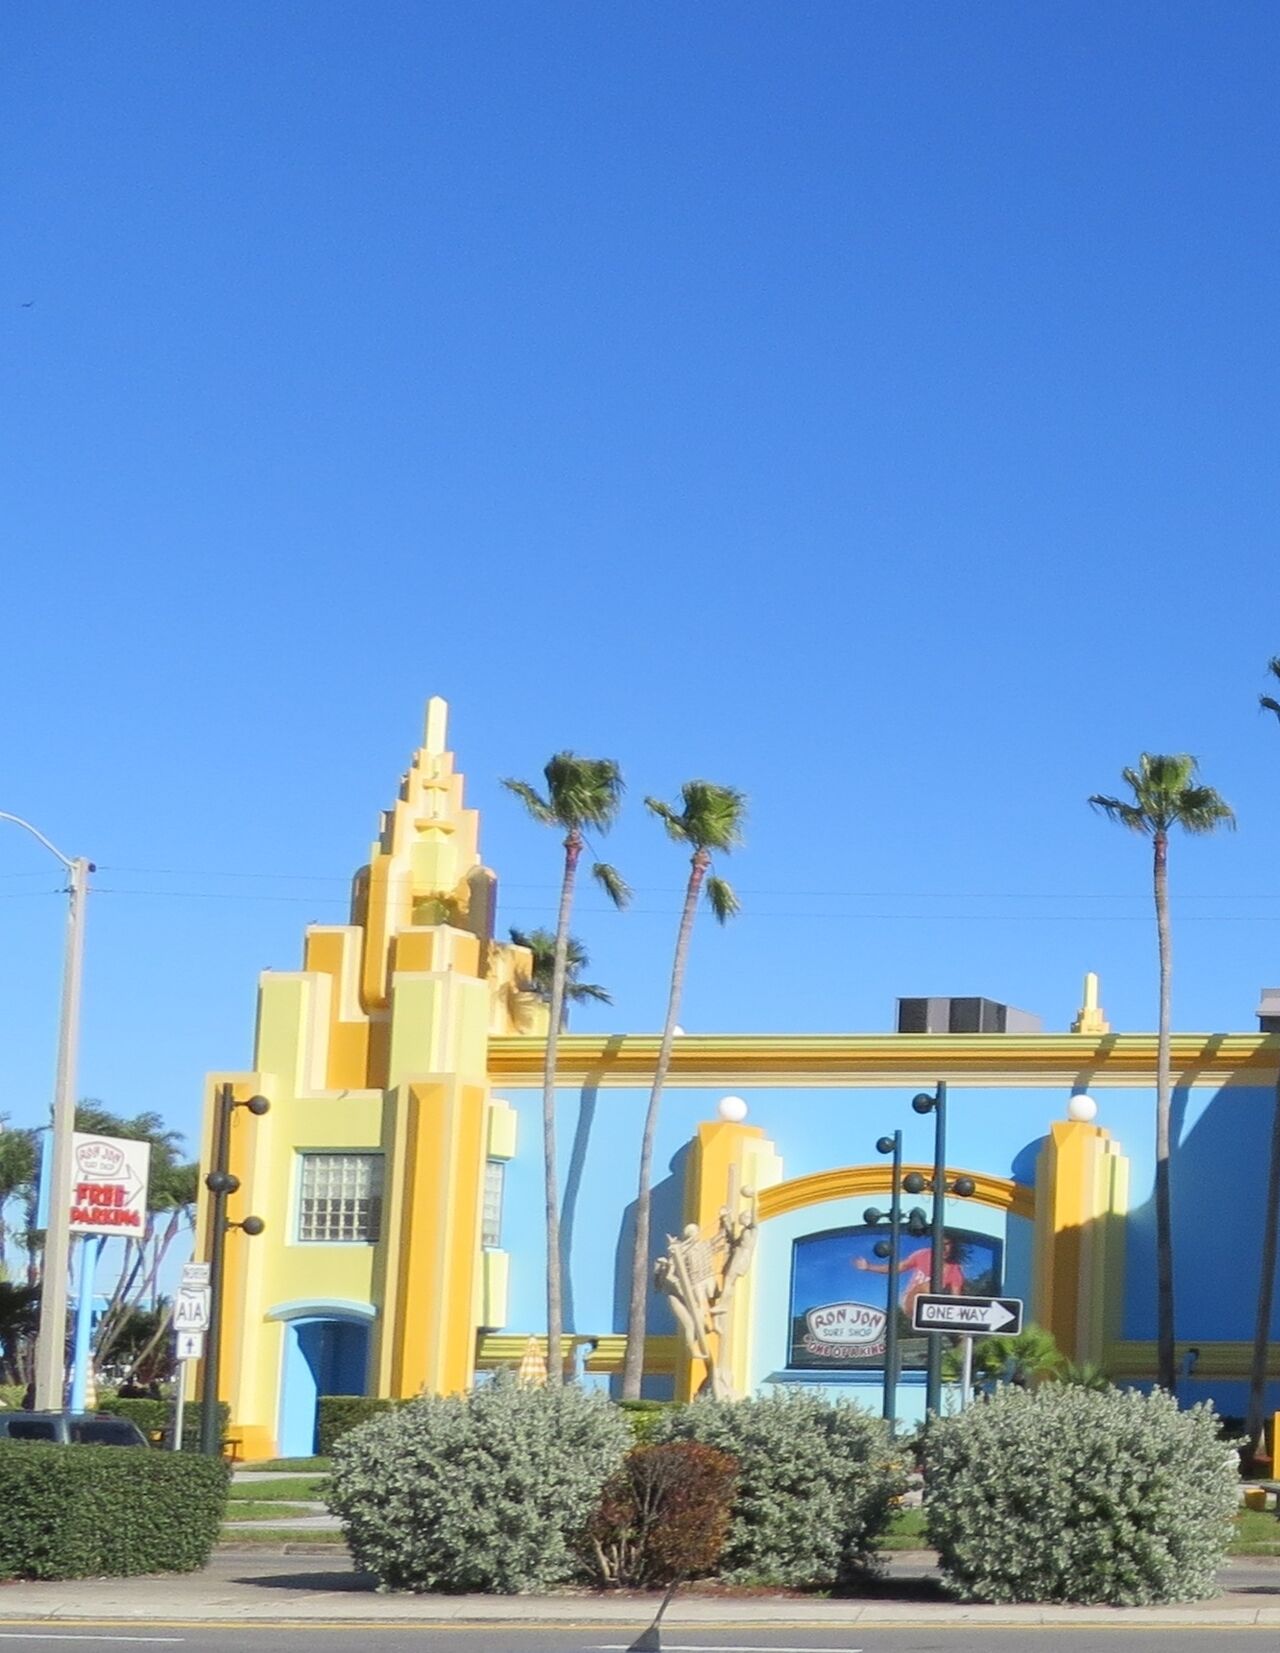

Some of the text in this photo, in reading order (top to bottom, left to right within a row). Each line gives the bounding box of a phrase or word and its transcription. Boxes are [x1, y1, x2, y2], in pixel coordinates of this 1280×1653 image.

[75, 1182, 125, 1207] FREE
[69, 1206, 141, 1227] PARKING
[177, 1302, 203, 1322] A1A
[815, 1309, 882, 1329] RON JON
[926, 1305, 989, 1321] ONE WAY
[823, 1327, 873, 1337] SURF SHOP
